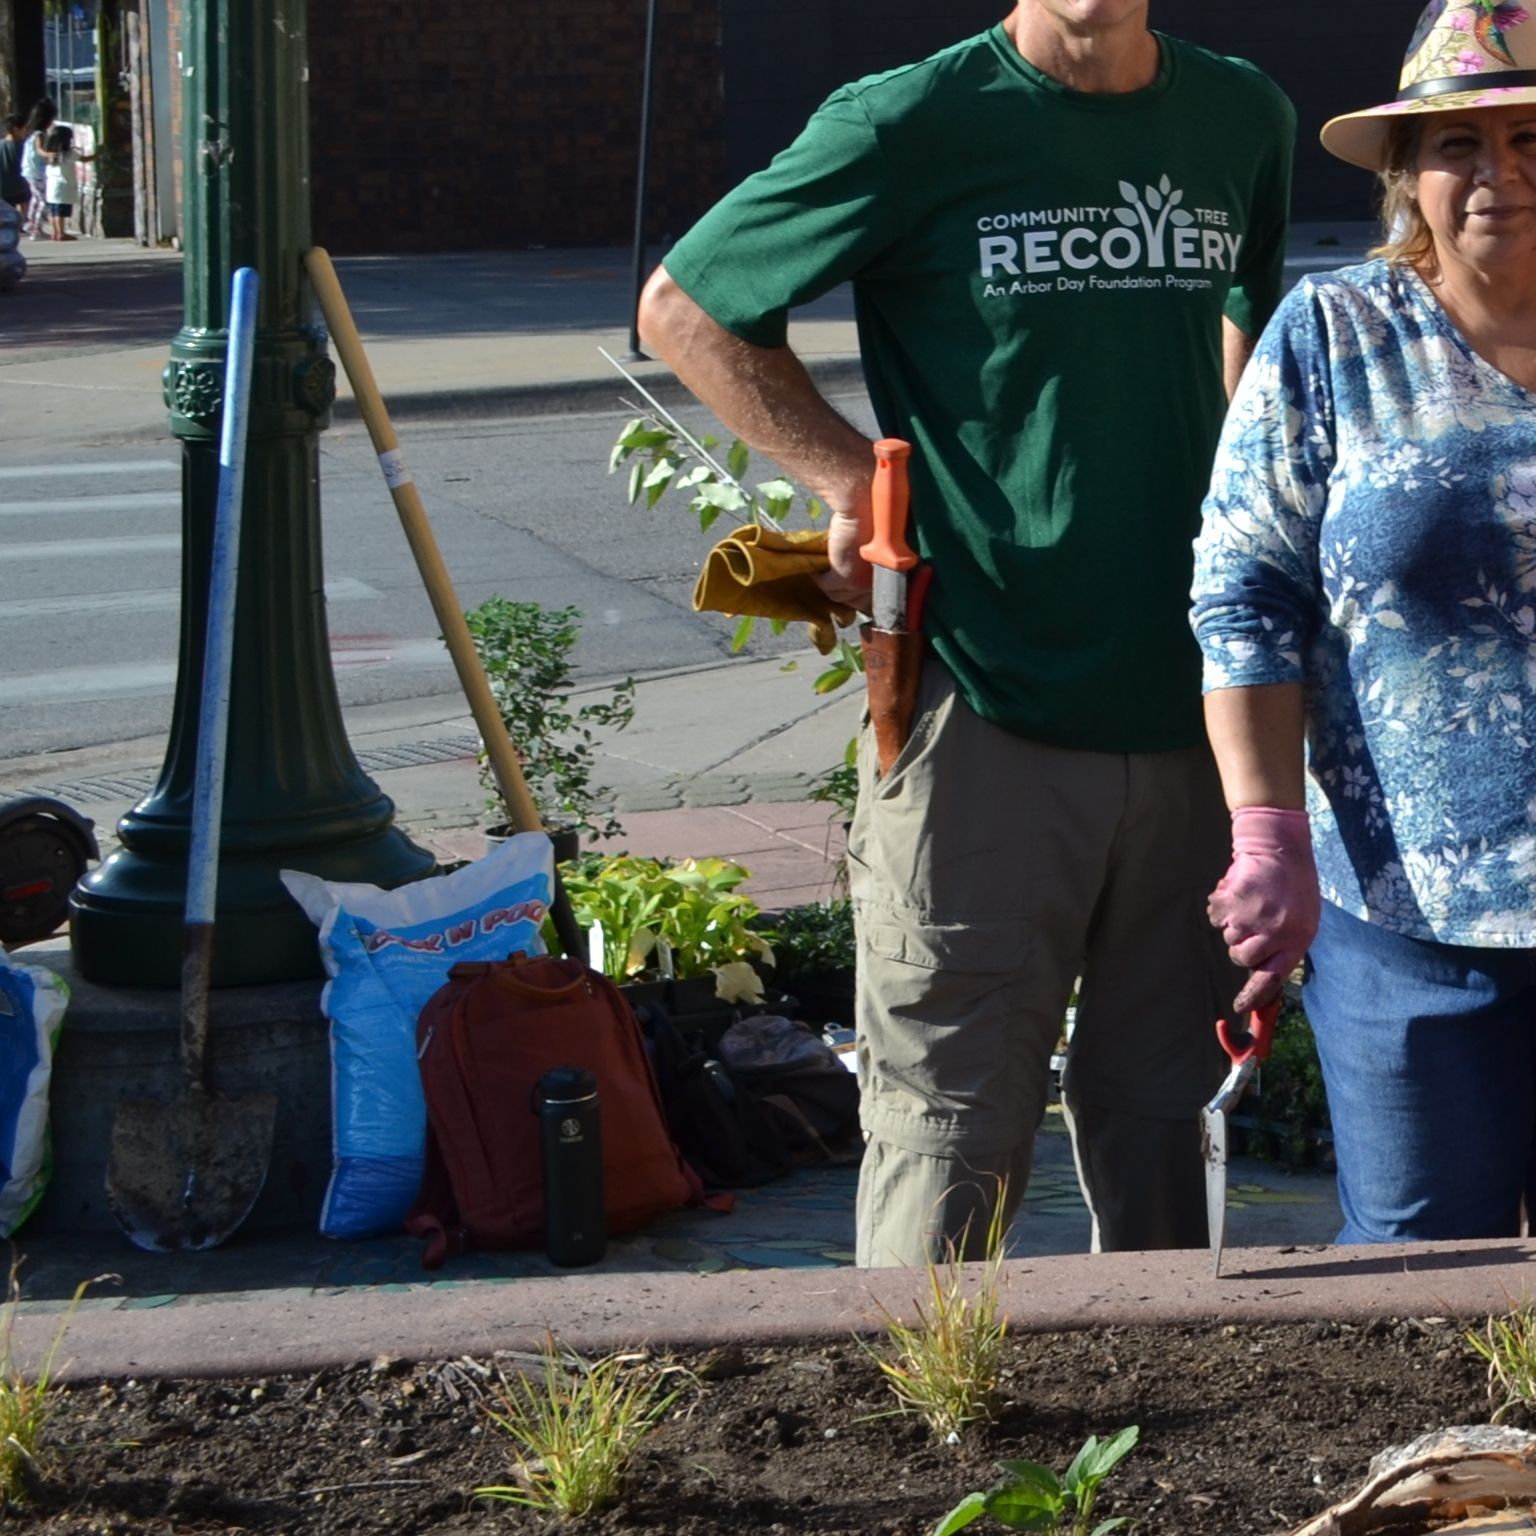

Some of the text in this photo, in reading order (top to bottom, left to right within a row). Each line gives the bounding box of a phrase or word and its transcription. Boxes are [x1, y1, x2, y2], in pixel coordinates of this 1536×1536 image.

[977, 207, 1229, 232] COMMUNITY TREE
[978, 224, 1243, 278] RECOVERY
[983, 275, 1213, 298] An Arbor Day Foundation Program
